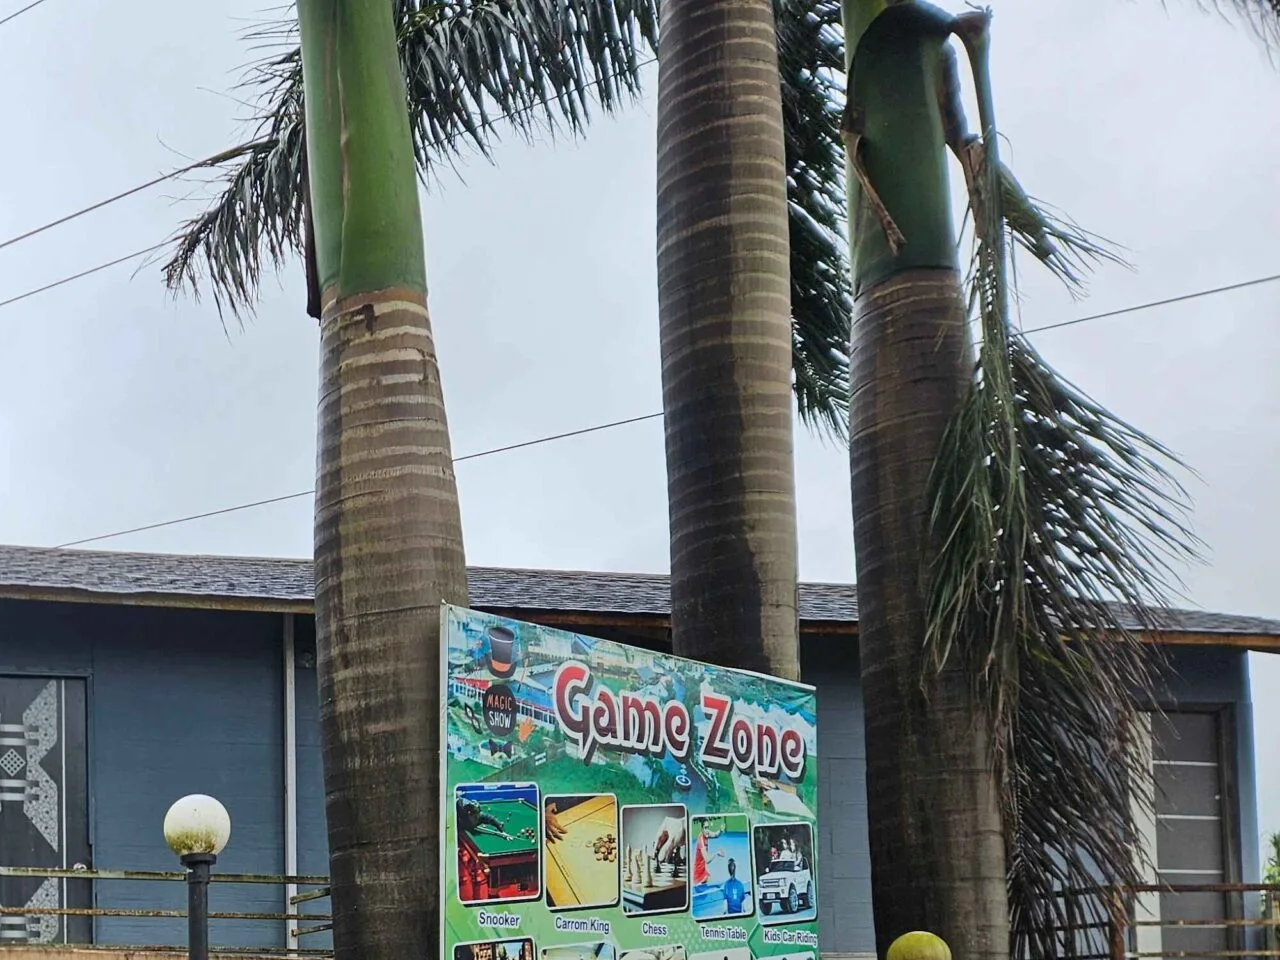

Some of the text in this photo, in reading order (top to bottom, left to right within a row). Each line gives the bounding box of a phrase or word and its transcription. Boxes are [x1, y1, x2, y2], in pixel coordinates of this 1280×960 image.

[486, 693, 513, 711] MAGIC
[488, 710, 512, 729] SHOW
[554, 660, 807, 779] Game Zone
[478, 911, 521, 927] Snooker
[555, 916, 610, 935] Carrom King
[642, 922, 667, 936] Chess
[700, 926, 747, 940] Tennis Table
[764, 929, 818, 947] Kids Car Riding
